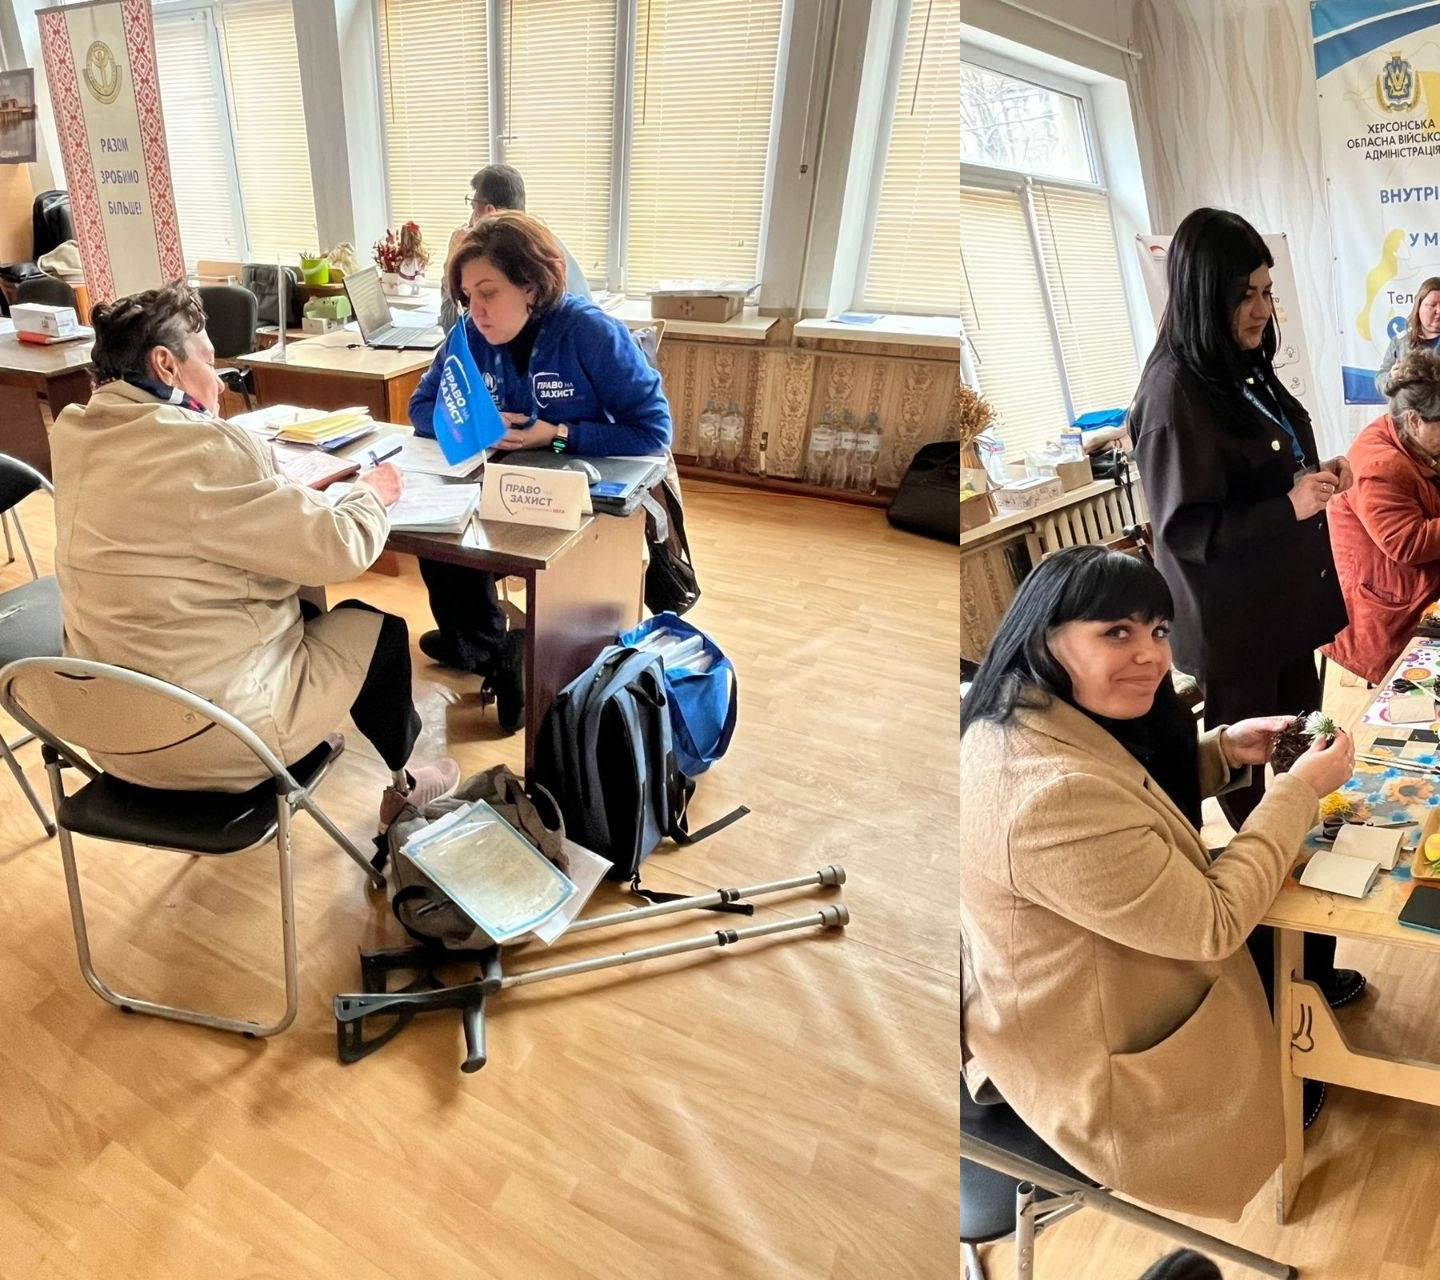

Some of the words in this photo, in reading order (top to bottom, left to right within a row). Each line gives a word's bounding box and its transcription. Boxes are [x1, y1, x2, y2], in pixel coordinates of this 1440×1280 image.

[1367, 119, 1436, 134] ХЕРСОНСЬКА
[100, 137, 129, 153] РАЗОМ
[1347, 136, 1396, 149] ОБЛАСНА
[1365, 145, 1440, 161] АДМІНІСТРАЦІЯ
[100, 170, 139, 185] ЗРОБИМО
[1409, 233, 1420, 247] У
[444, 366, 466, 408] ПРАВО
[537, 381, 563, 390] ПРАВО
[540, 389, 574, 398] ЗАХИСТ
[440, 380, 464, 425] ЗАХИСТ
[505, 483, 541, 495] ПРАВО
[510, 494, 552, 506] ЗАХИСТ
